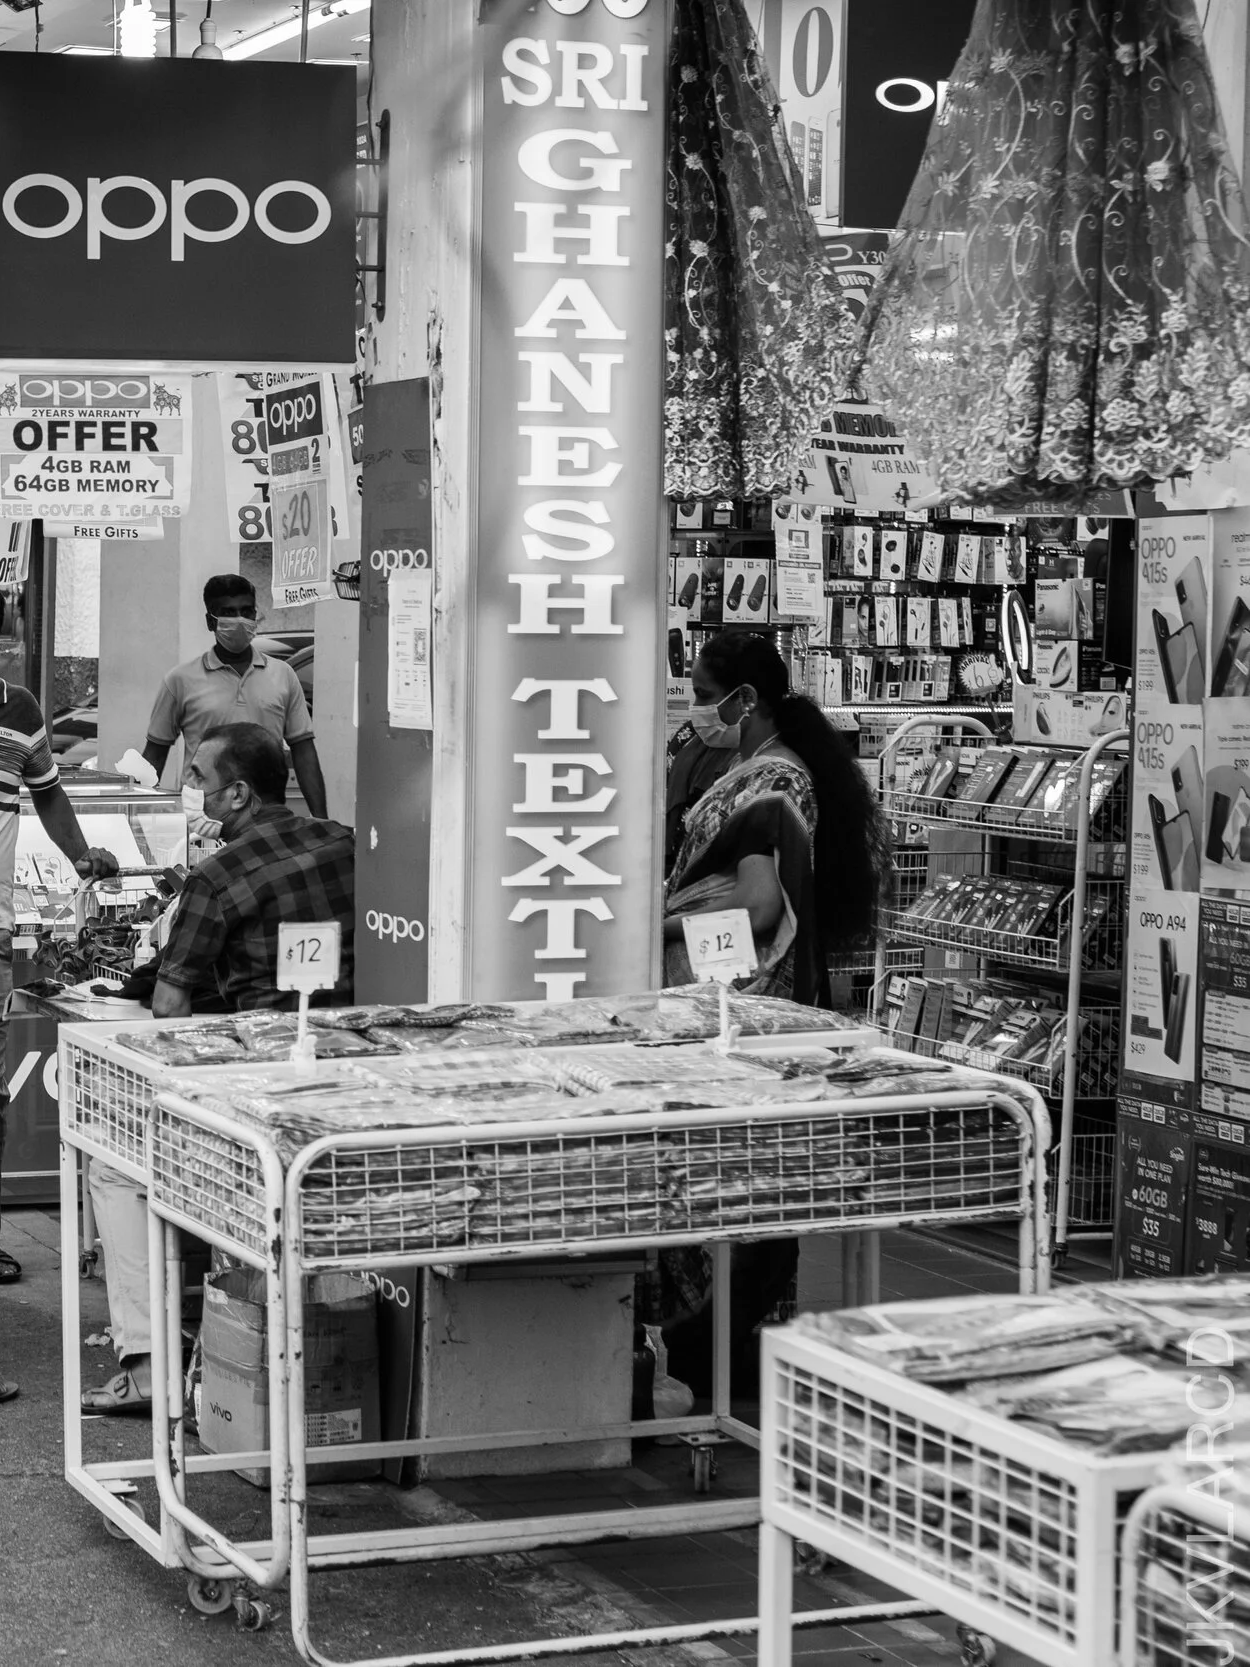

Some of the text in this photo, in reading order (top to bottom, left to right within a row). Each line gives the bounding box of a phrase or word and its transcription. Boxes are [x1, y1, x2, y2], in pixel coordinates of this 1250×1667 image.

[501, 37, 648, 111] SRI
[2, 173, 332, 262] oppo
[838, 274, 871, 287] Offer
[507, 128, 632, 634] GHANESH
[22, 379, 148, 406] oppo
[31, 409, 140, 418] 2YEARS WARRANTY
[270, 394, 316, 435] oppo
[12, 420, 159, 452] OFFER
[837, 440, 905, 455] WARRANTY
[41, 455, 131, 474] 4GB RAM
[871, 459, 921, 475] 4GB RAM
[14, 475, 159, 492] 64GB MEMORY
[38, 503, 95, 517] COVER
[101, 504, 111, 517] &
[116, 504, 181, 517] T.GLASS
[1025, 502, 1059, 514] FREE
[73, 525, 139, 539] FREE GIFTS
[1141, 537, 1176, 559] OPPO
[281, 546, 318, 580] OFFER
[370, 549, 428, 577] oppo
[1142, 562, 1168, 584] A15s
[1137, 722, 1174, 745] OPPO
[1137, 747, 1165, 769] A15s
[365, 909, 425, 943] oppo
[1140, 912, 1186, 932] OPPO A94
[286, 938, 321, 964] $12
[1137, 1156, 1174, 1174] ALL YOU NEED
[1138, 1167, 1172, 1184] IN ONE PLAN
[1138, 1185, 1168, 1208] 60GB
[1142, 1216, 1160, 1237] $35
[209, 1401, 232, 1422] vivo
